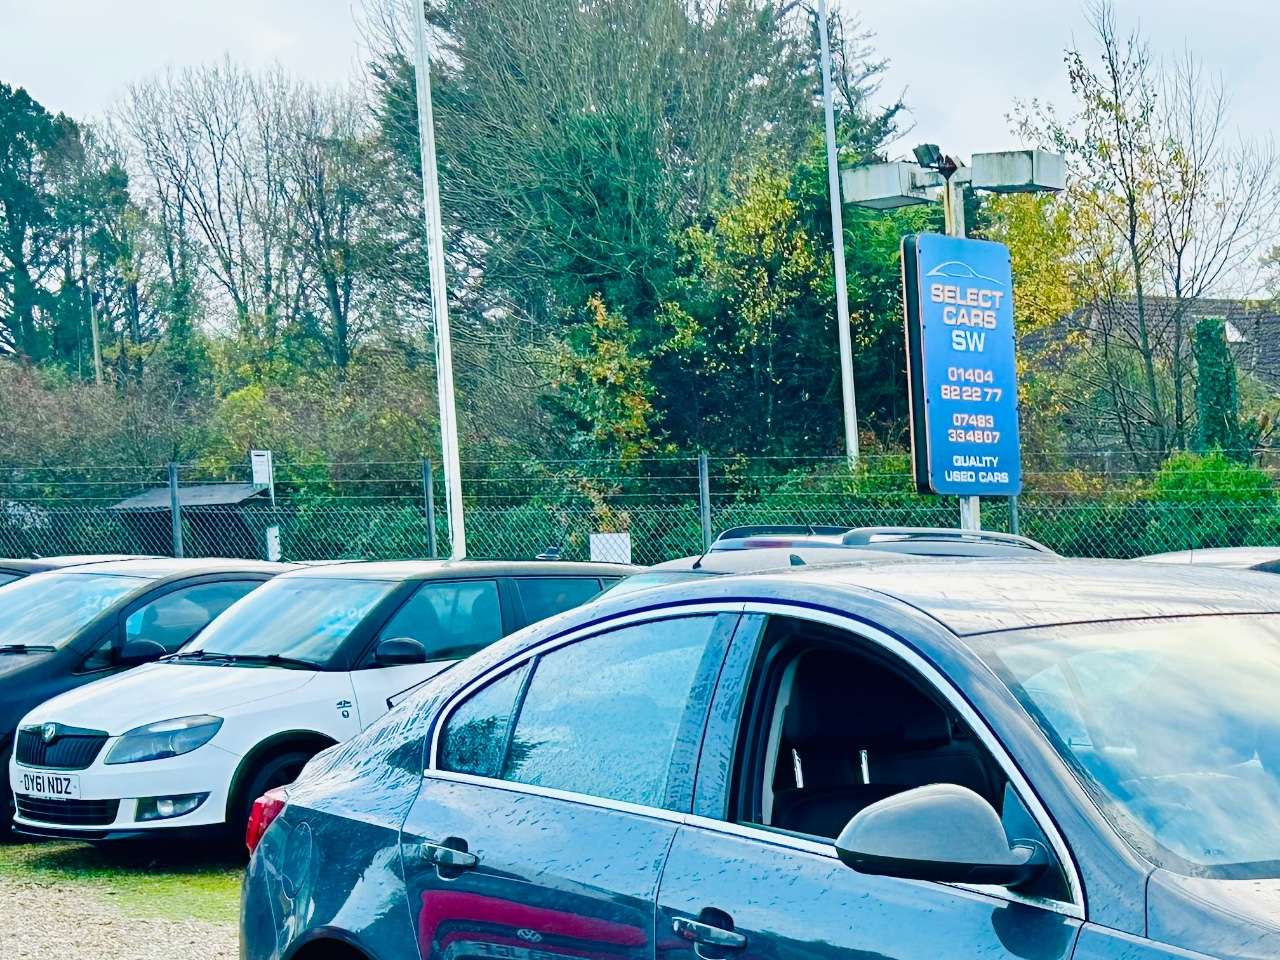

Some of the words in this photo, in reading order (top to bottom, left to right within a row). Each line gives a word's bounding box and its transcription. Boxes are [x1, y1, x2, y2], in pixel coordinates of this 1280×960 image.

[931, 283, 1004, 310] SELECT
[943, 305, 997, 330] CARS
[952, 329, 985, 353] SW
[948, 366, 994, 384] 01404
[941, 384, 960, 400] 82
[962, 386, 982, 402] 22
[983, 388, 1002, 403] 77
[952, 413, 995, 428] 07483
[947, 429, 1001, 444] 334807
[952, 455, 999, 468] QUALITY
[944, 470, 976, 483] USED
[978, 471, 1009, 484] CARS
[23, 773, 45, 793] OY61
[47, 776, 72, 795] NDZ
